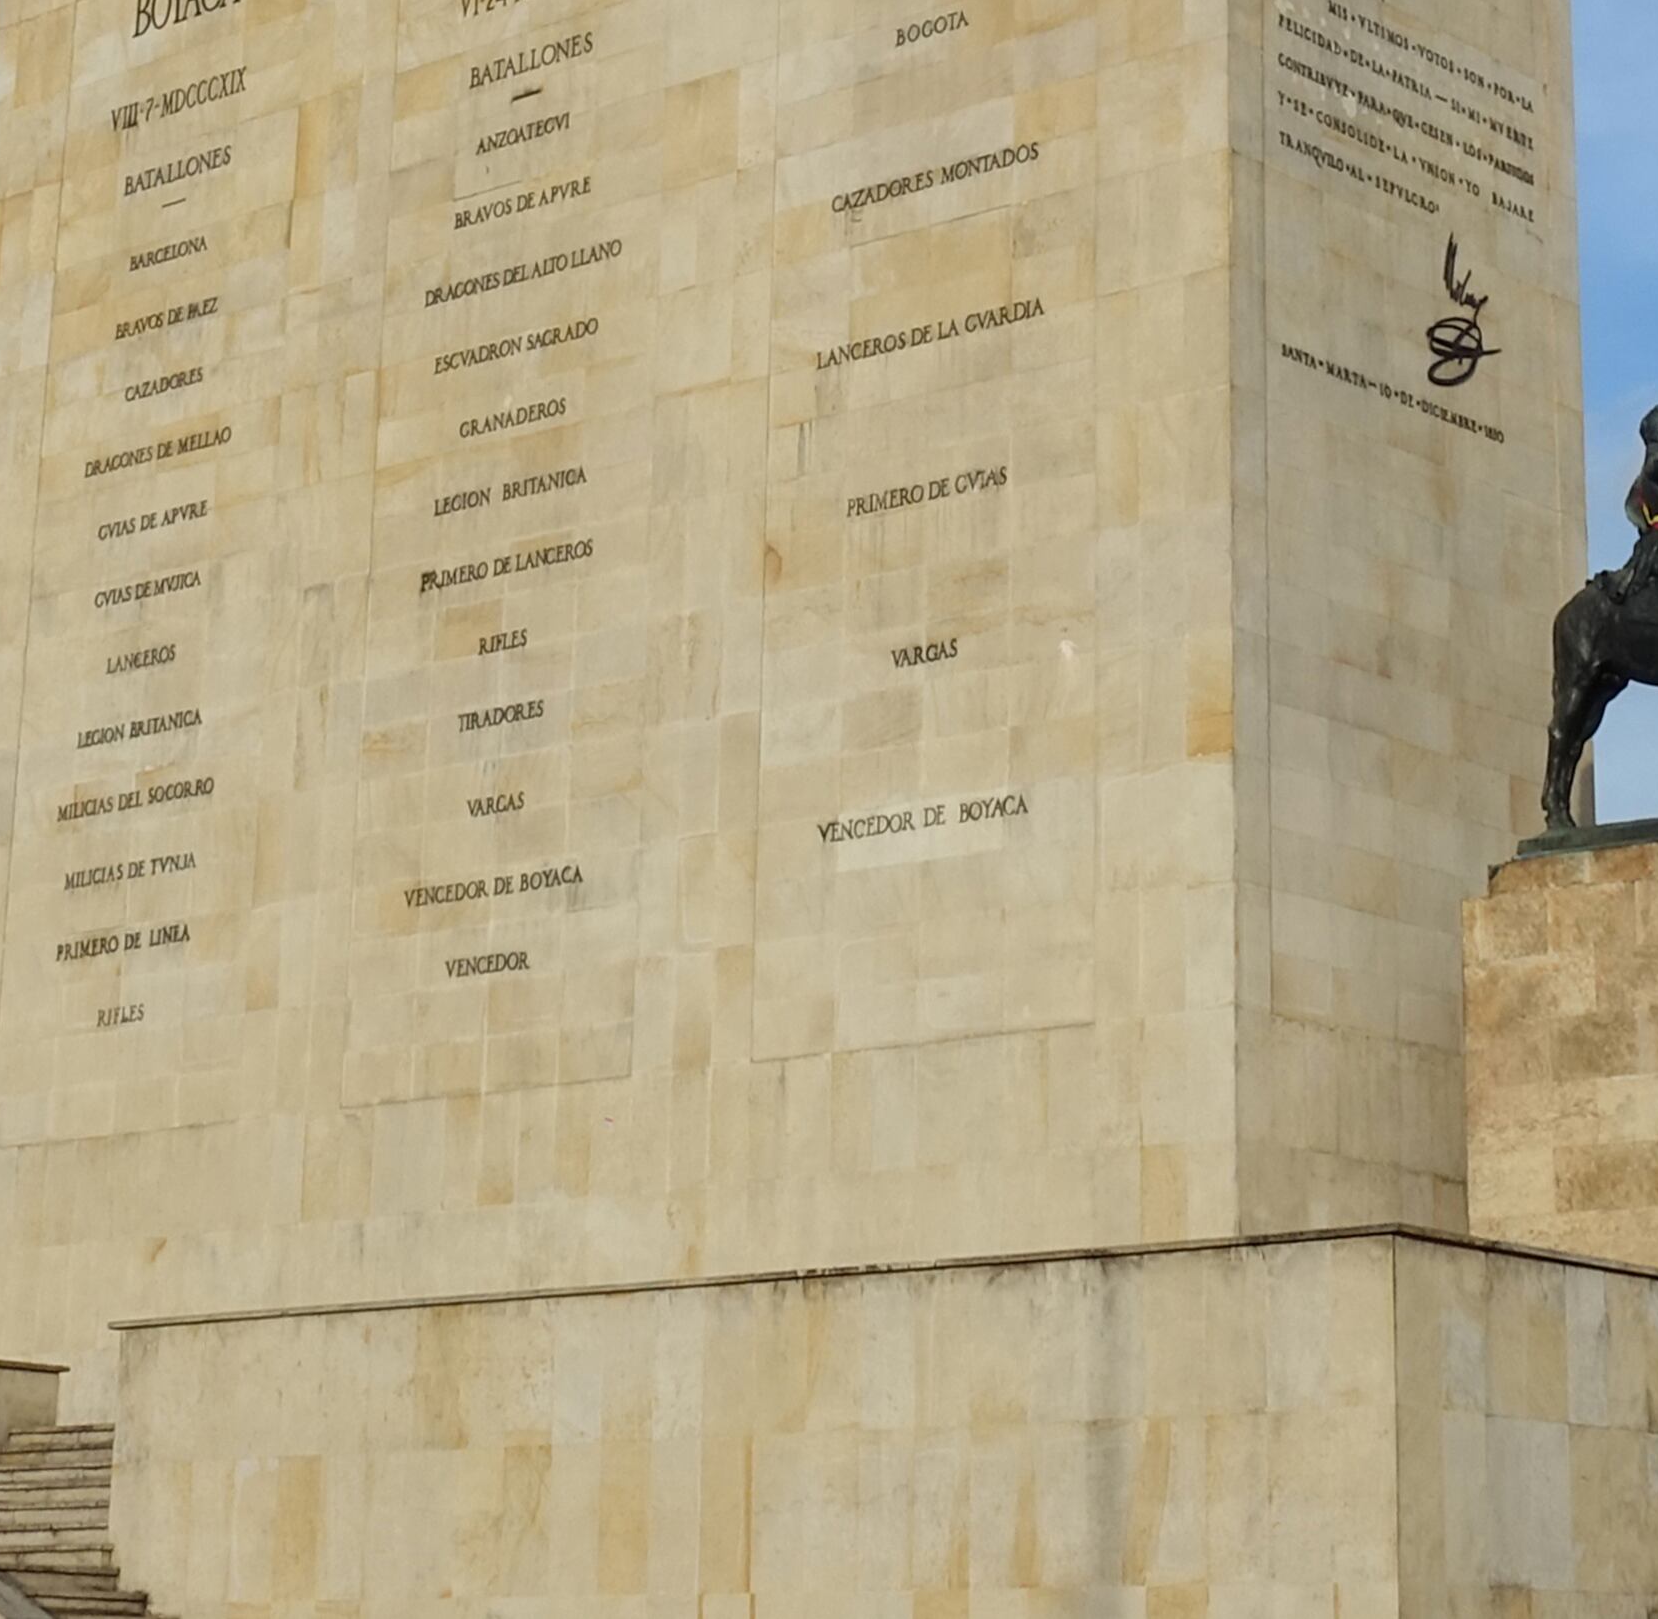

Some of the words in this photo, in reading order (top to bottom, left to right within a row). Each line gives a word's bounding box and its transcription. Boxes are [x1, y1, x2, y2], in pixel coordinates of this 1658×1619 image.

[895, 10, 970, 48] BOGOTA
[469, 31, 593, 90] BATALLONES
[124, 145, 232, 196] BATALLONES
[832, 170, 934, 213] CAZADORES
[940, 142, 1039, 185] MONTADOS
[454, 198, 512, 230] BRAVOS
[516, 191, 536, 213] DE
[129, 236, 208, 271] BARCELONA
[502, 264, 530, 287] DEL
[531, 254, 569, 280] ALTO
[570, 239, 622, 269] LLANO
[115, 313, 163, 340] BRAVOS
[167, 306, 184, 326] DE
[816, 332, 906, 371] LANCEROS
[910, 324, 933, 347] DE
[937, 318, 960, 341] LA
[125, 367, 203, 401] CAZADORES
[459, 397, 566, 438] GRANADEROS
[157, 441, 173, 460] DE
[502, 465, 587, 502] BRITANICA
[846, 484, 924, 518] PRIMERO
[928, 478, 950, 501] DE
[140, 513, 157, 531] DE
[419, 561, 488, 594] PRIMERO
[493, 556, 512, 578] DE
[515, 539, 593, 572] LANCEROS
[135, 581, 152, 601] DE
[106, 644, 176, 674] LANCEROS
[478, 628, 528, 656] RIFLES
[891, 638, 959, 668] VARGAS
[129, 708, 202, 739] BRITANICA
[457, 699, 544, 733] TIRADORES
[57, 796, 113, 822] MILICIAS
[118, 790, 143, 811] DEL
[147, 777, 215, 804] SOCORRO
[817, 811, 916, 844] VENCEDOR
[923, 805, 946, 827] DE
[959, 794, 1029, 823] BOYACA
[64, 864, 123, 891] MILICIAS
[127, 860, 145, 879] DE
[404, 879, 489, 908] VENCEDOR
[493, 875, 514, 896] DE
[519, 865, 584, 892] BOYACA
[56, 935, 119, 962] PRIMERO
[124, 932, 141, 951] DE
[149, 924, 191, 947] LINEA
[445, 951, 530, 979] VENCEDOR
[97, 1003, 145, 1028] RIFLES
